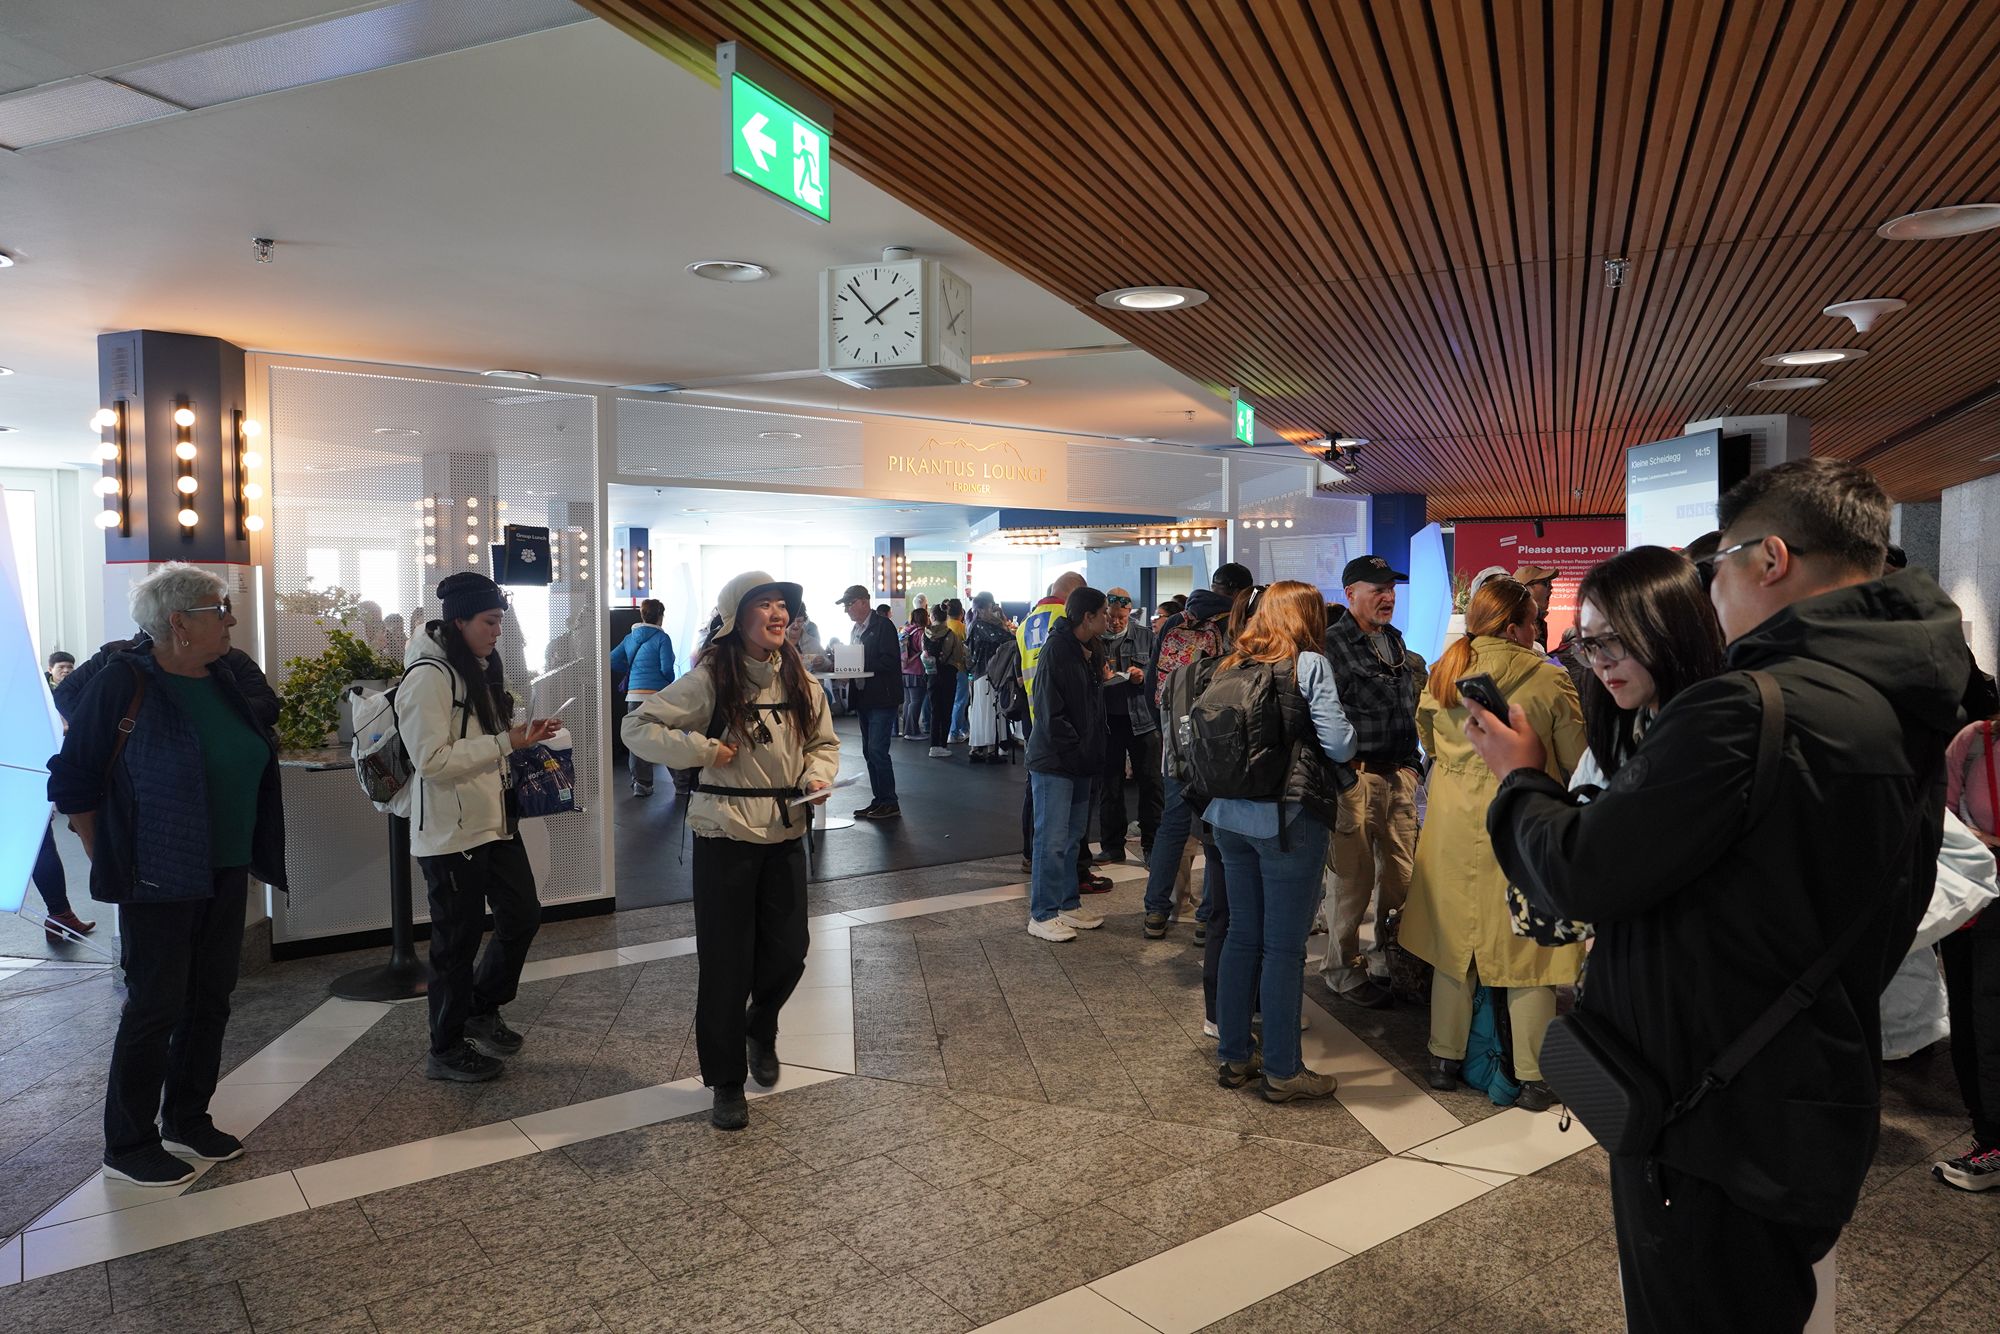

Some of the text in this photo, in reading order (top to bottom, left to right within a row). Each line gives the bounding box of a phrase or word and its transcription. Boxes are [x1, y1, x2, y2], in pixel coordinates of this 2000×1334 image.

[1695, 446, 1711, 457] 14:15
[1649, 453, 1681, 466] Scheidegg
[888, 455, 1047, 483] PIKANTUS LOUNGE
[952, 481, 991, 493] ERDINGER
[1518, 546, 1552, 554] Please
[1555, 546, 1588, 555] stamp
